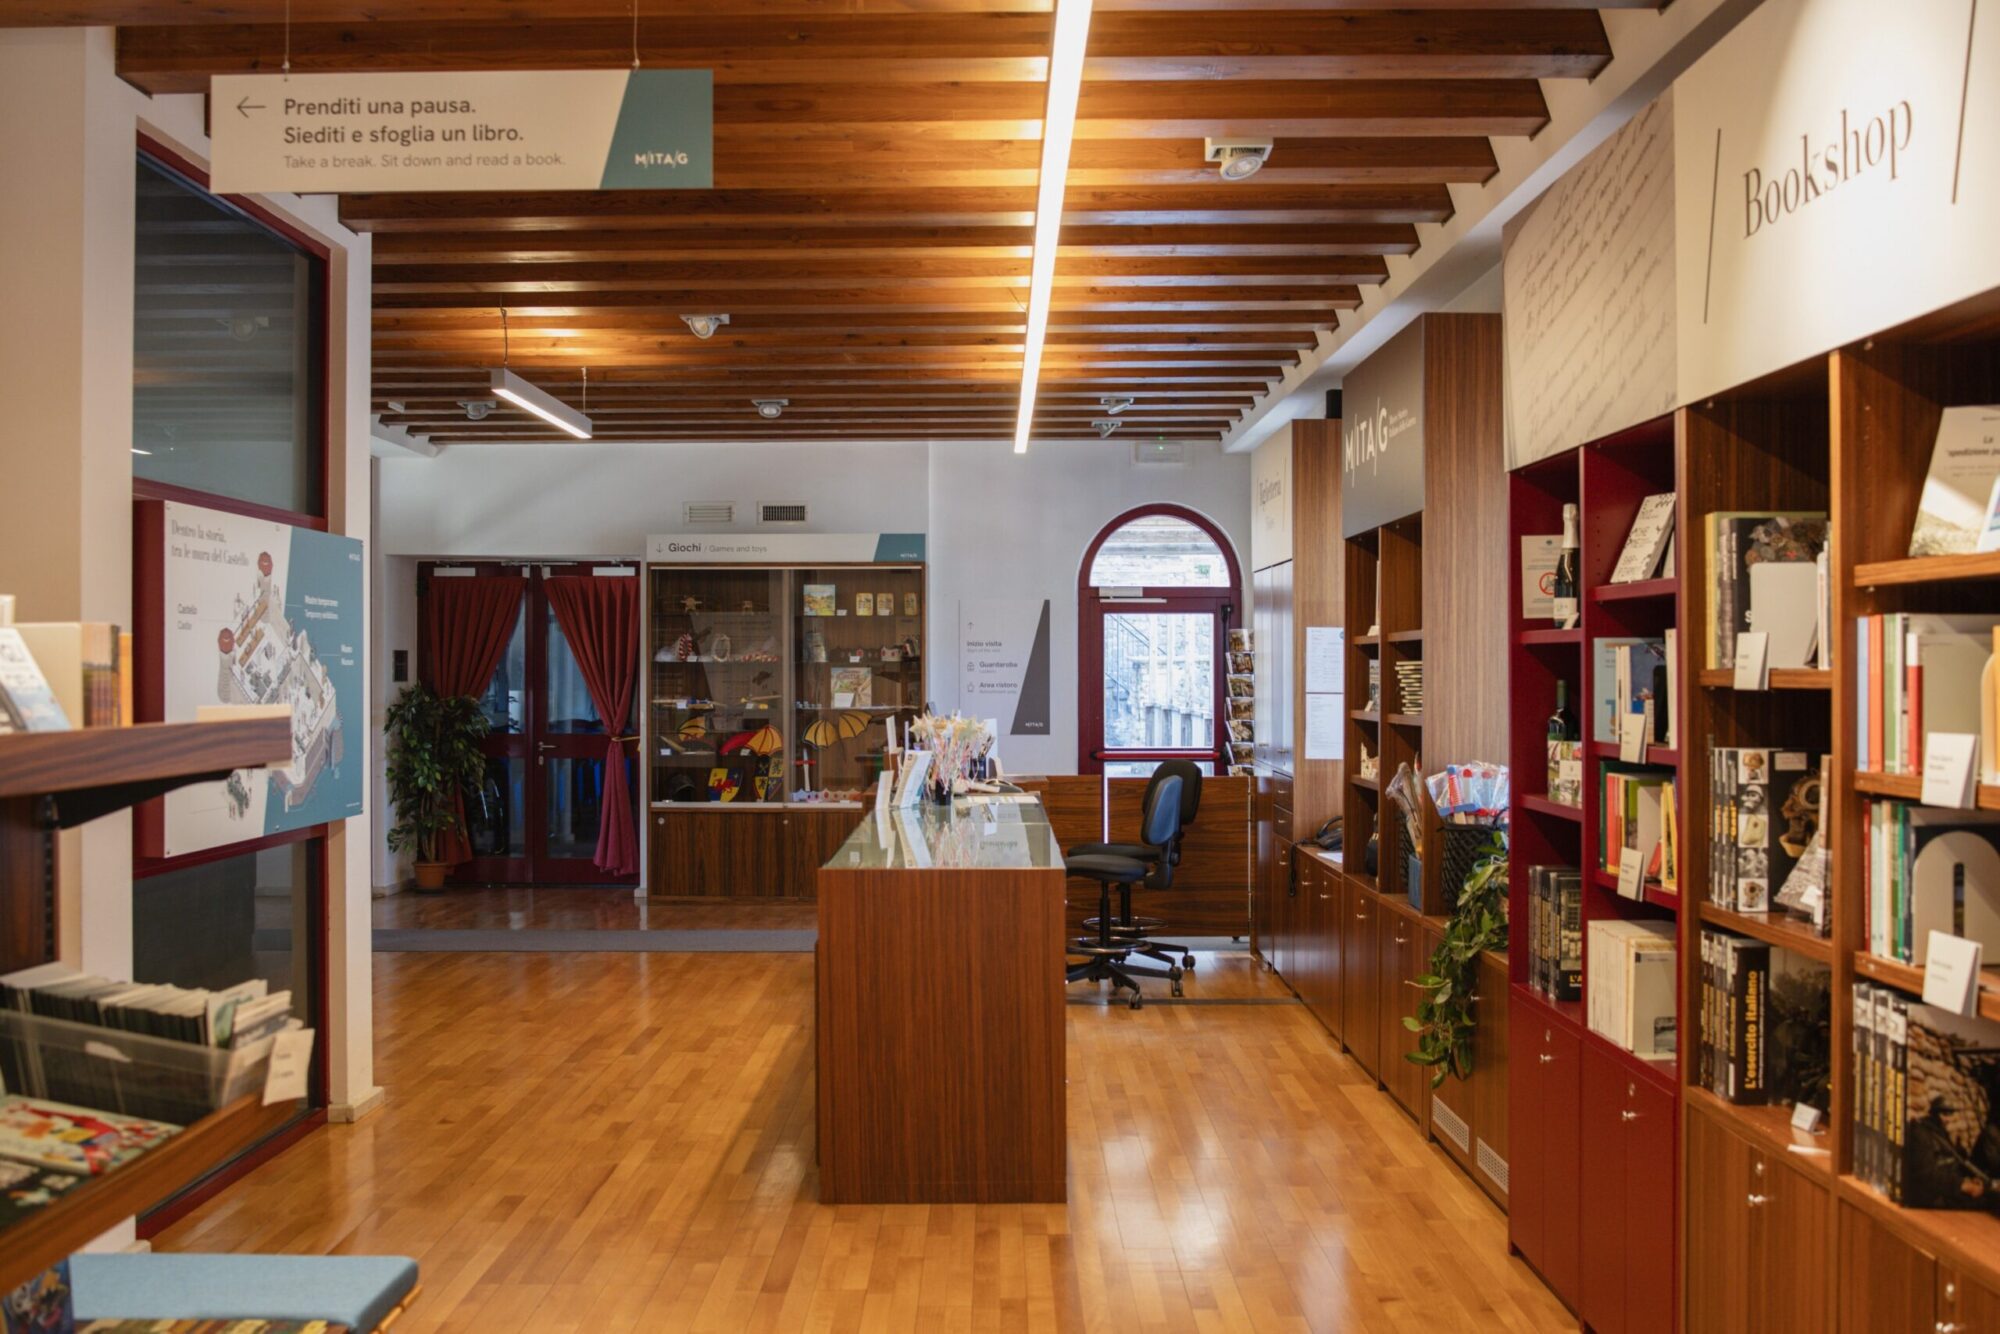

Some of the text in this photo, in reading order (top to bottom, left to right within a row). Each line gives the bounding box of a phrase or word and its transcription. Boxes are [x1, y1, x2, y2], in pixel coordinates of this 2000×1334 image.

[284, 98, 476, 119] Prenditi una pausa.
[284, 123, 524, 147] Siediti e sfoglia un libro.
[285, 153, 565, 168] Take a break. Sit down and read a book.
[1743, 99, 1912, 239] Bookshop
[668, 543, 701, 552] Giochi
[1745, 970, 1757, 1021] italiano
